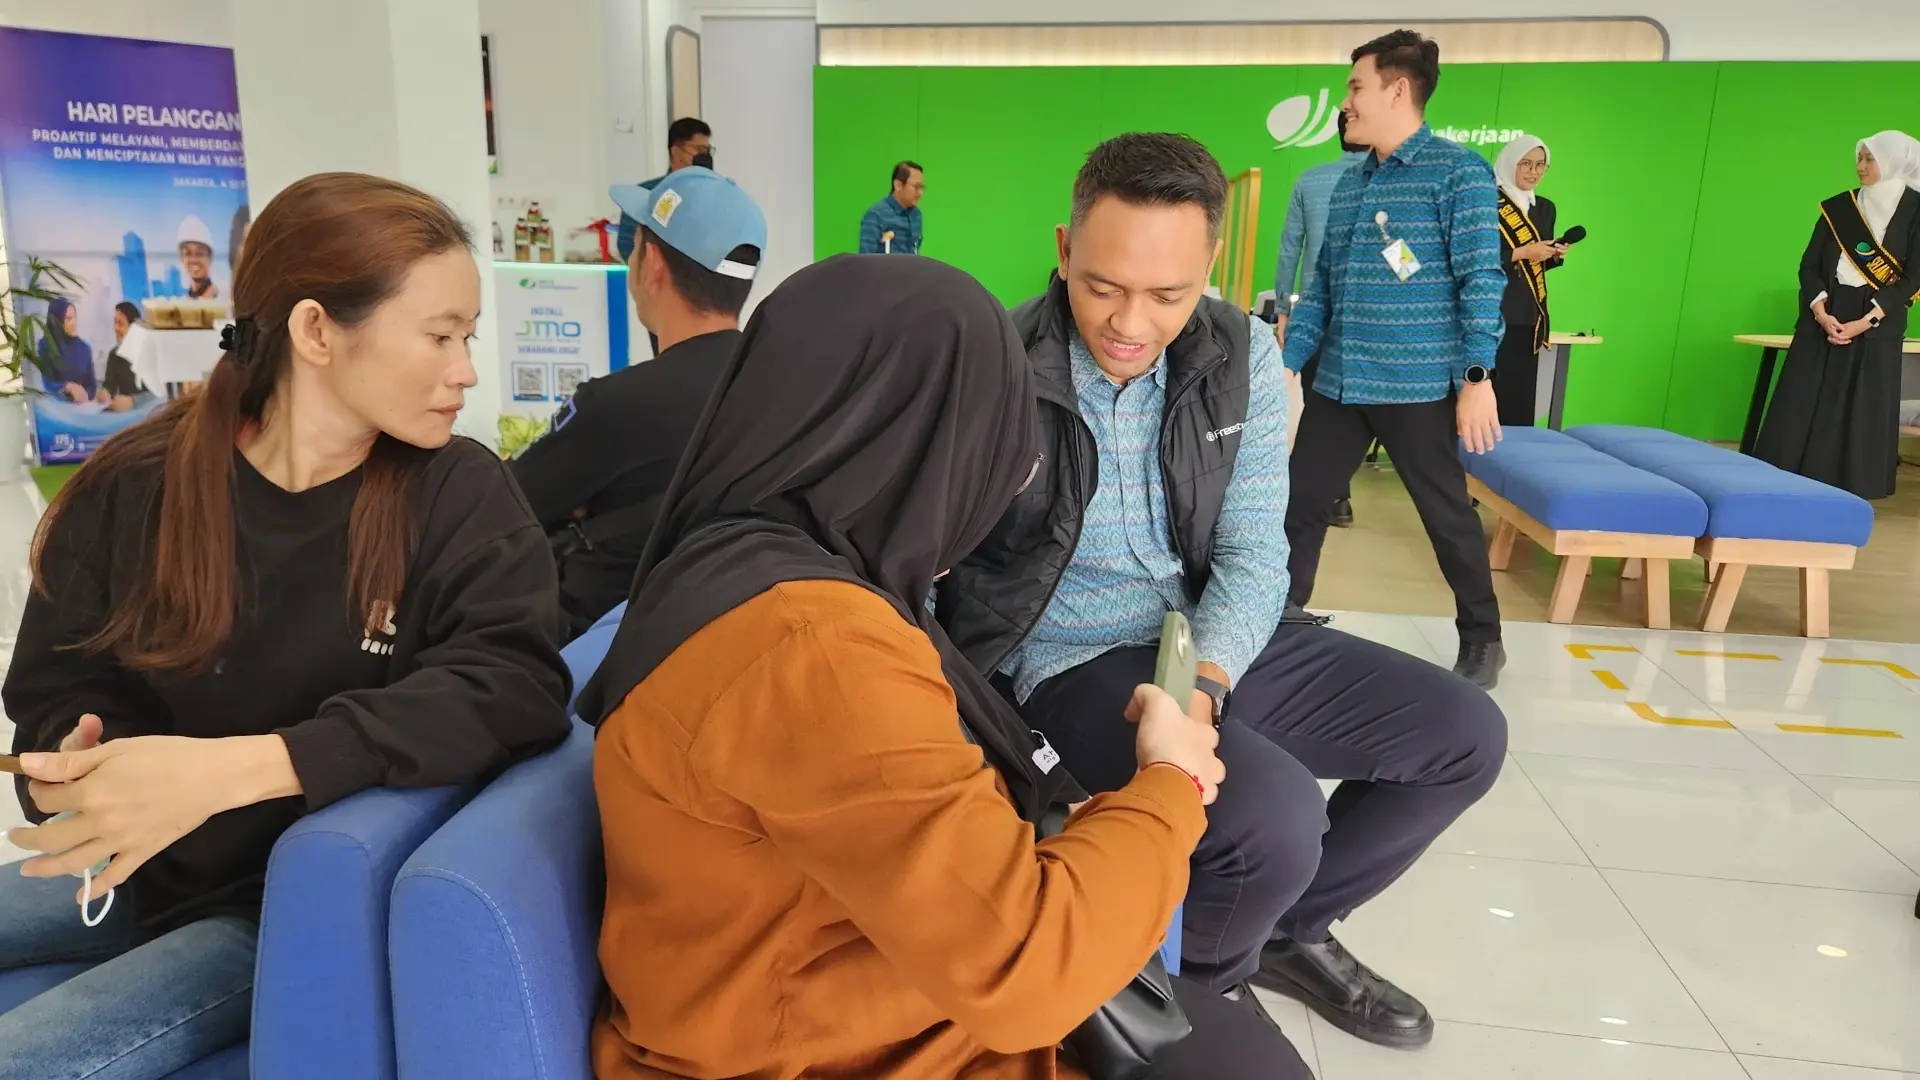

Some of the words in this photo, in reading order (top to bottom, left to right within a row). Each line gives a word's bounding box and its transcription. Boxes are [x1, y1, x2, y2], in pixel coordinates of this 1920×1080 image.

[66, 100, 118, 124] HARI
[122, 104, 242, 131] PELANGGAN
[32, 128, 97, 143] PROAKTIF
[101, 133, 168, 149] MELAYANI,
[1431, 124, 1524, 146] akerjaan
[53, 146, 82, 160] DAN
[86, 148, 176, 164] MENCIPTAKAN
[178, 152, 211, 166] NILAI
